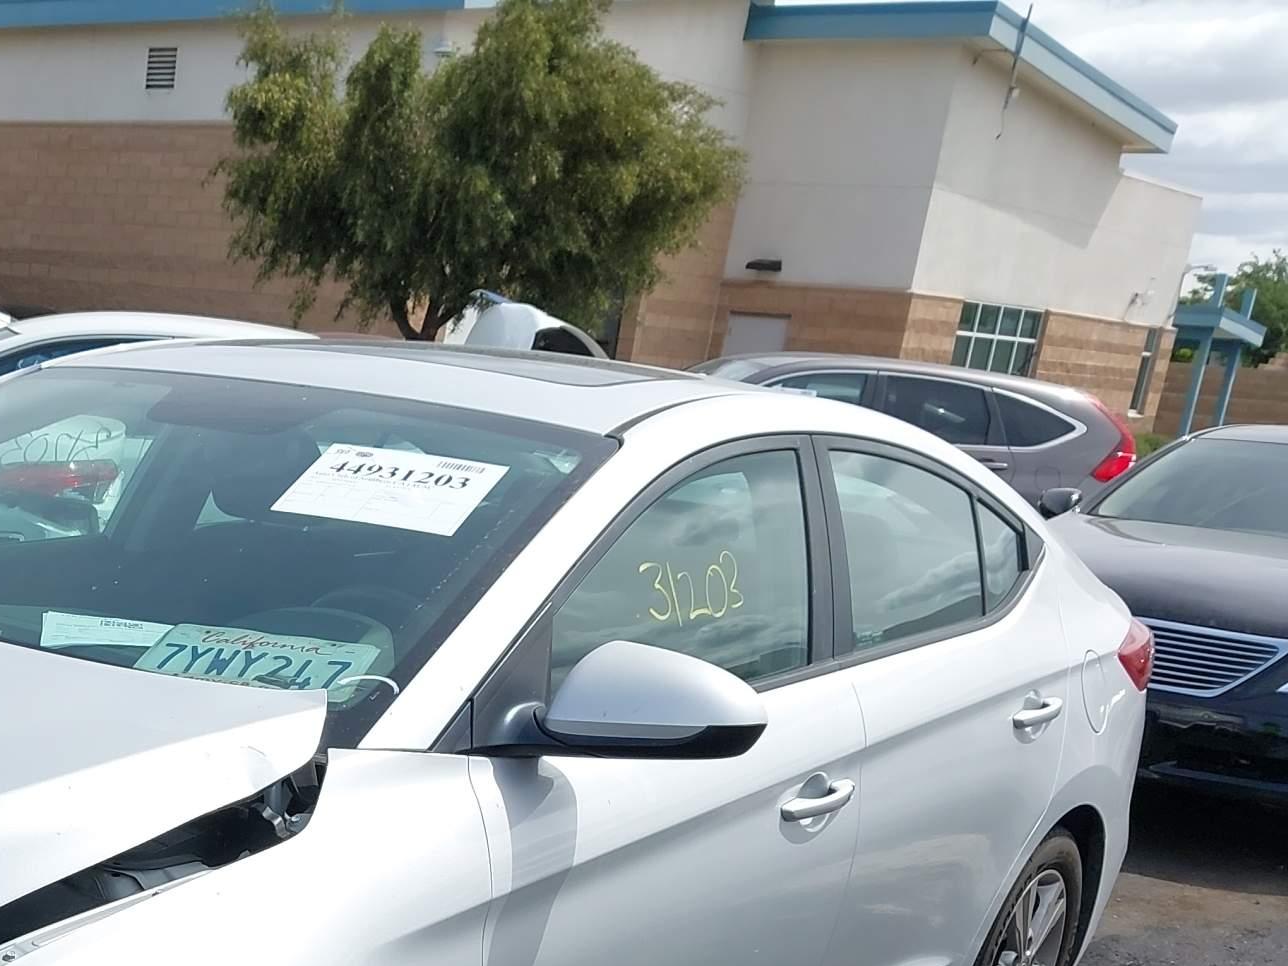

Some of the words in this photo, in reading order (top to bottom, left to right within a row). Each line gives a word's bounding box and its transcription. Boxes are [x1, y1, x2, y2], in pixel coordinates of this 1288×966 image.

[329, 460, 471, 491] 44931203
[638, 549, 745, 628] 31203
[201, 631, 334, 656] California
